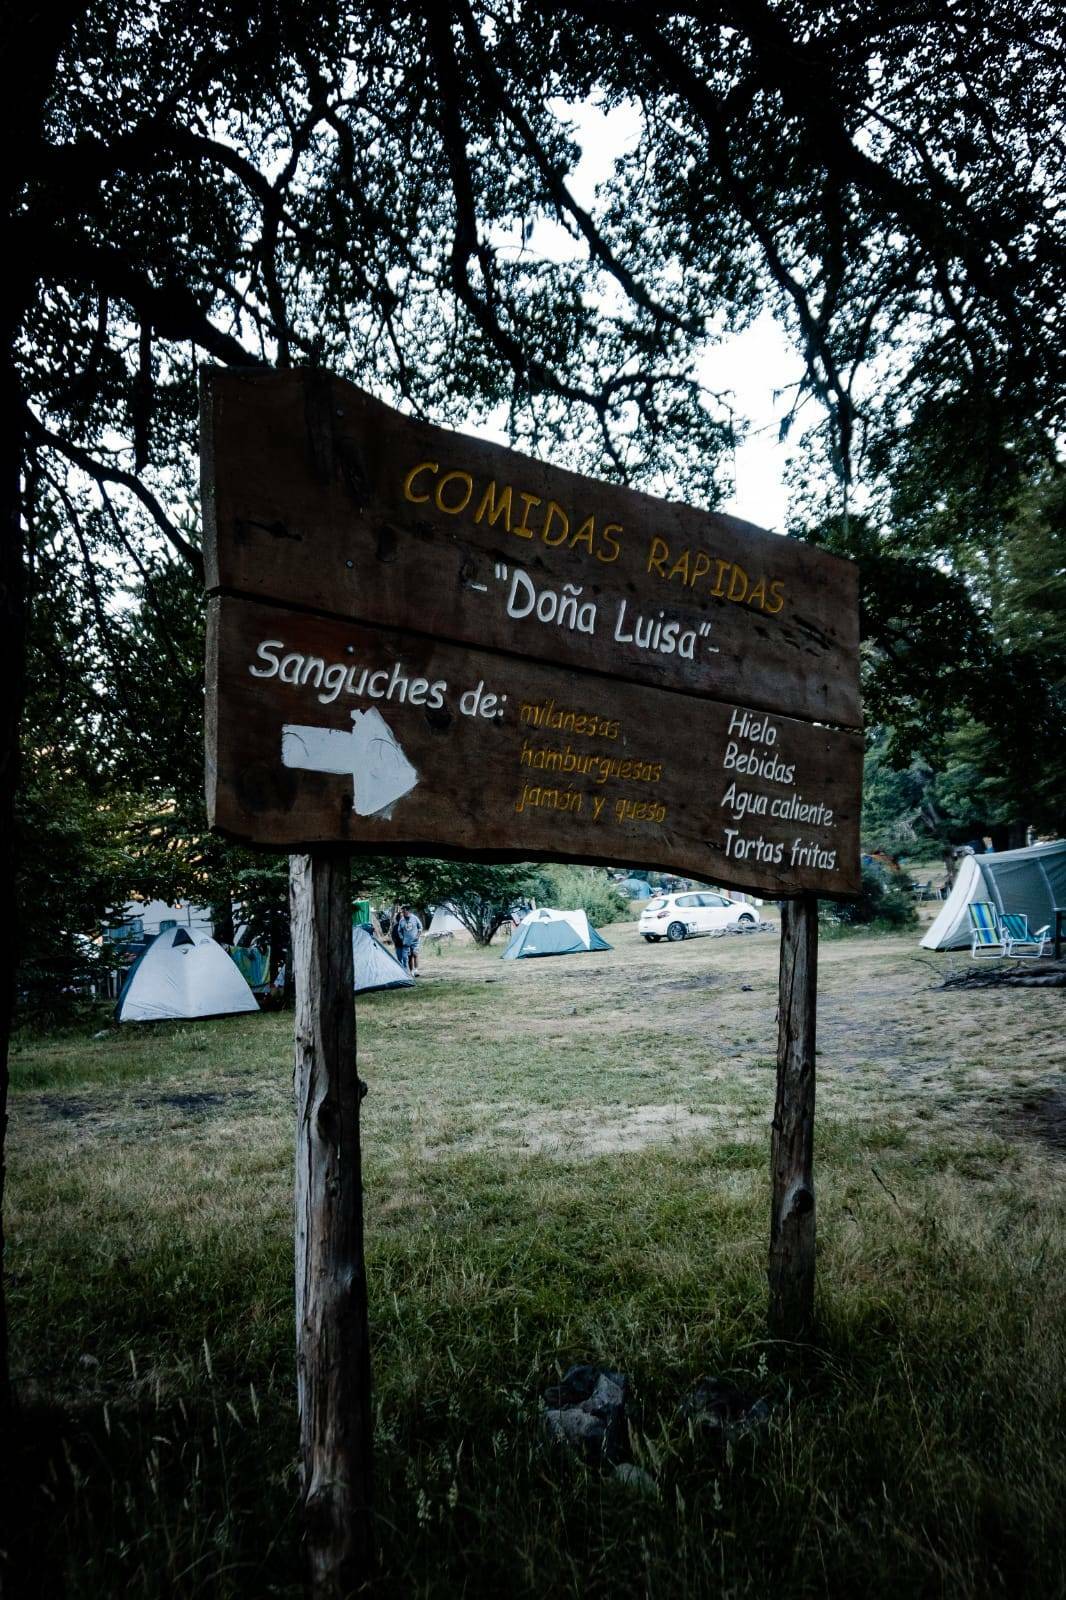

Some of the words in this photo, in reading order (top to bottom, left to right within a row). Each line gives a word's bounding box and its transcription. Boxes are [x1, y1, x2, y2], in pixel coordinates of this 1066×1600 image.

[403, 462, 624, 562] COMIDAS
[647, 536, 785, 614] RAPIDAS
[249, 640, 447, 709] Sanguches
[459, 680, 507, 718] de:
[520, 699, 620, 739] milanesas
[520, 740, 662, 784] hamburguesas
[515, 779, 582, 813] jamón
[592, 795, 606, 822] y
[615, 799, 667, 824] queso
[721, 782, 767, 820] Agua
[724, 828, 785, 864] Tortas
